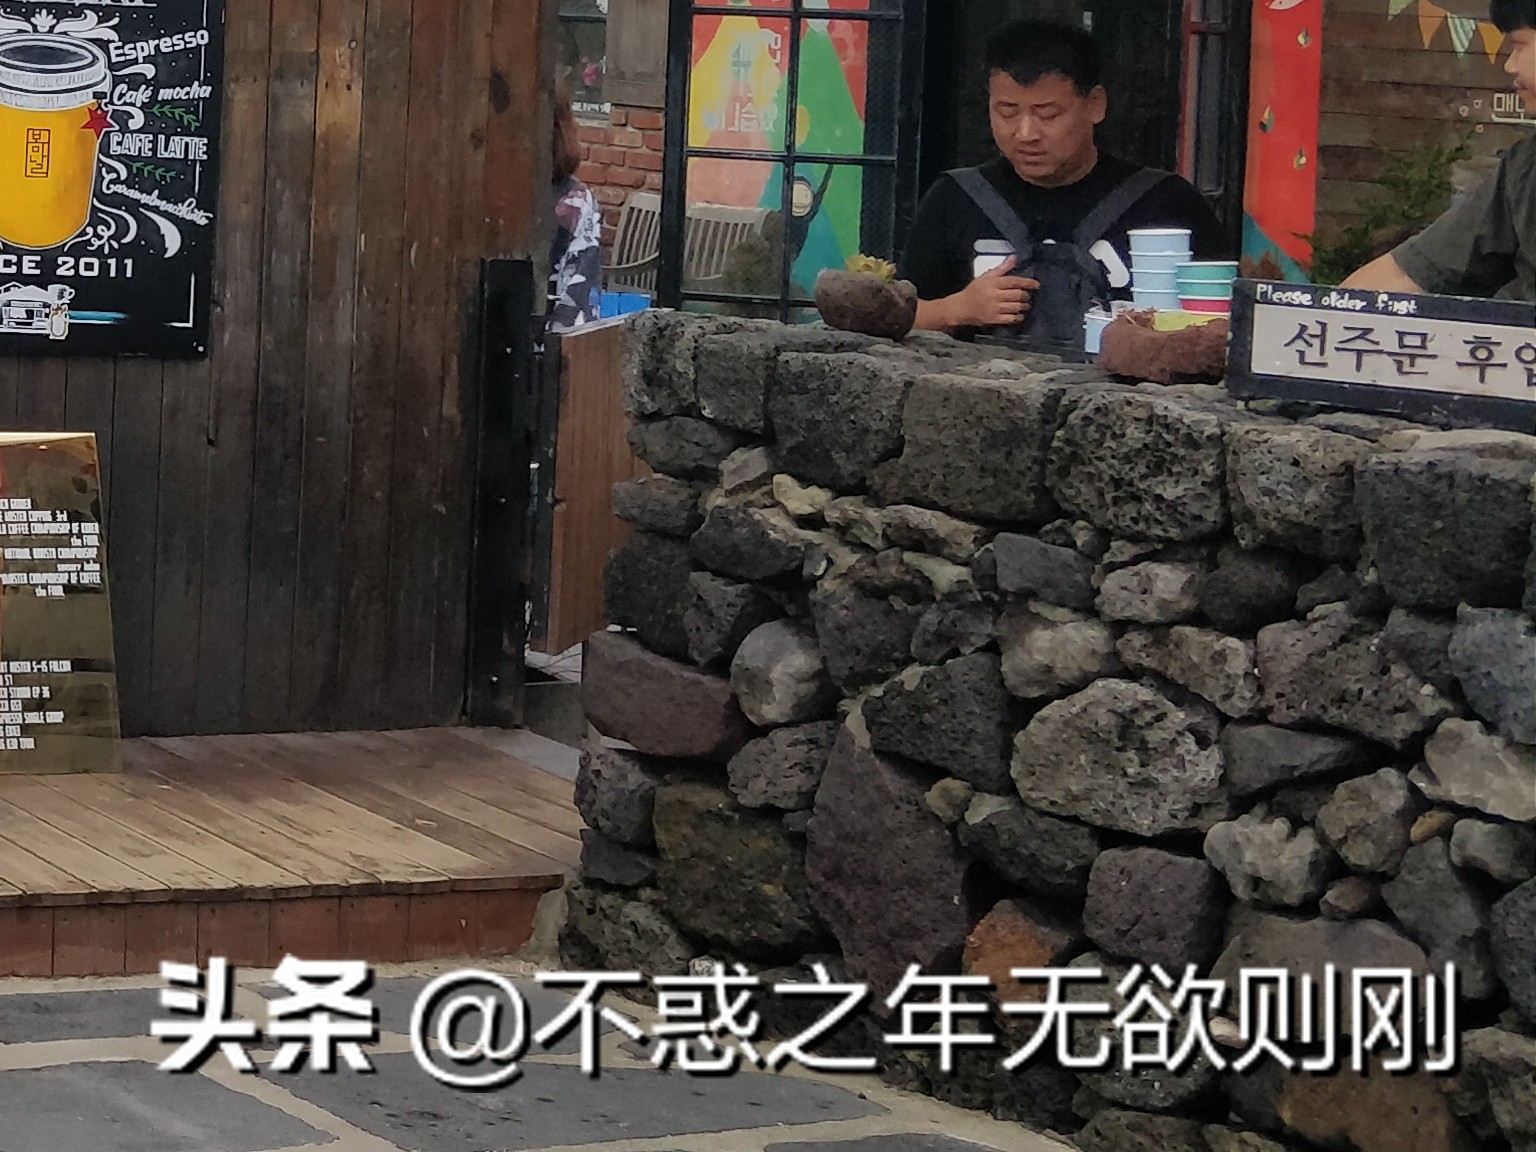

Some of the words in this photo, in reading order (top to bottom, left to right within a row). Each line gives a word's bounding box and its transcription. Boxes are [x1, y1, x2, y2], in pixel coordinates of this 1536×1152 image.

[108, 29, 211, 63] Espresso
[157, 80, 212, 101] mocha
[109, 132, 154, 157] CAFE
[156, 134, 209, 161] LATTE
[55, 256, 134, 279] 2011
[1256, 282, 1314, 307] Please
[1284, 319, 1439, 376] 선주문
